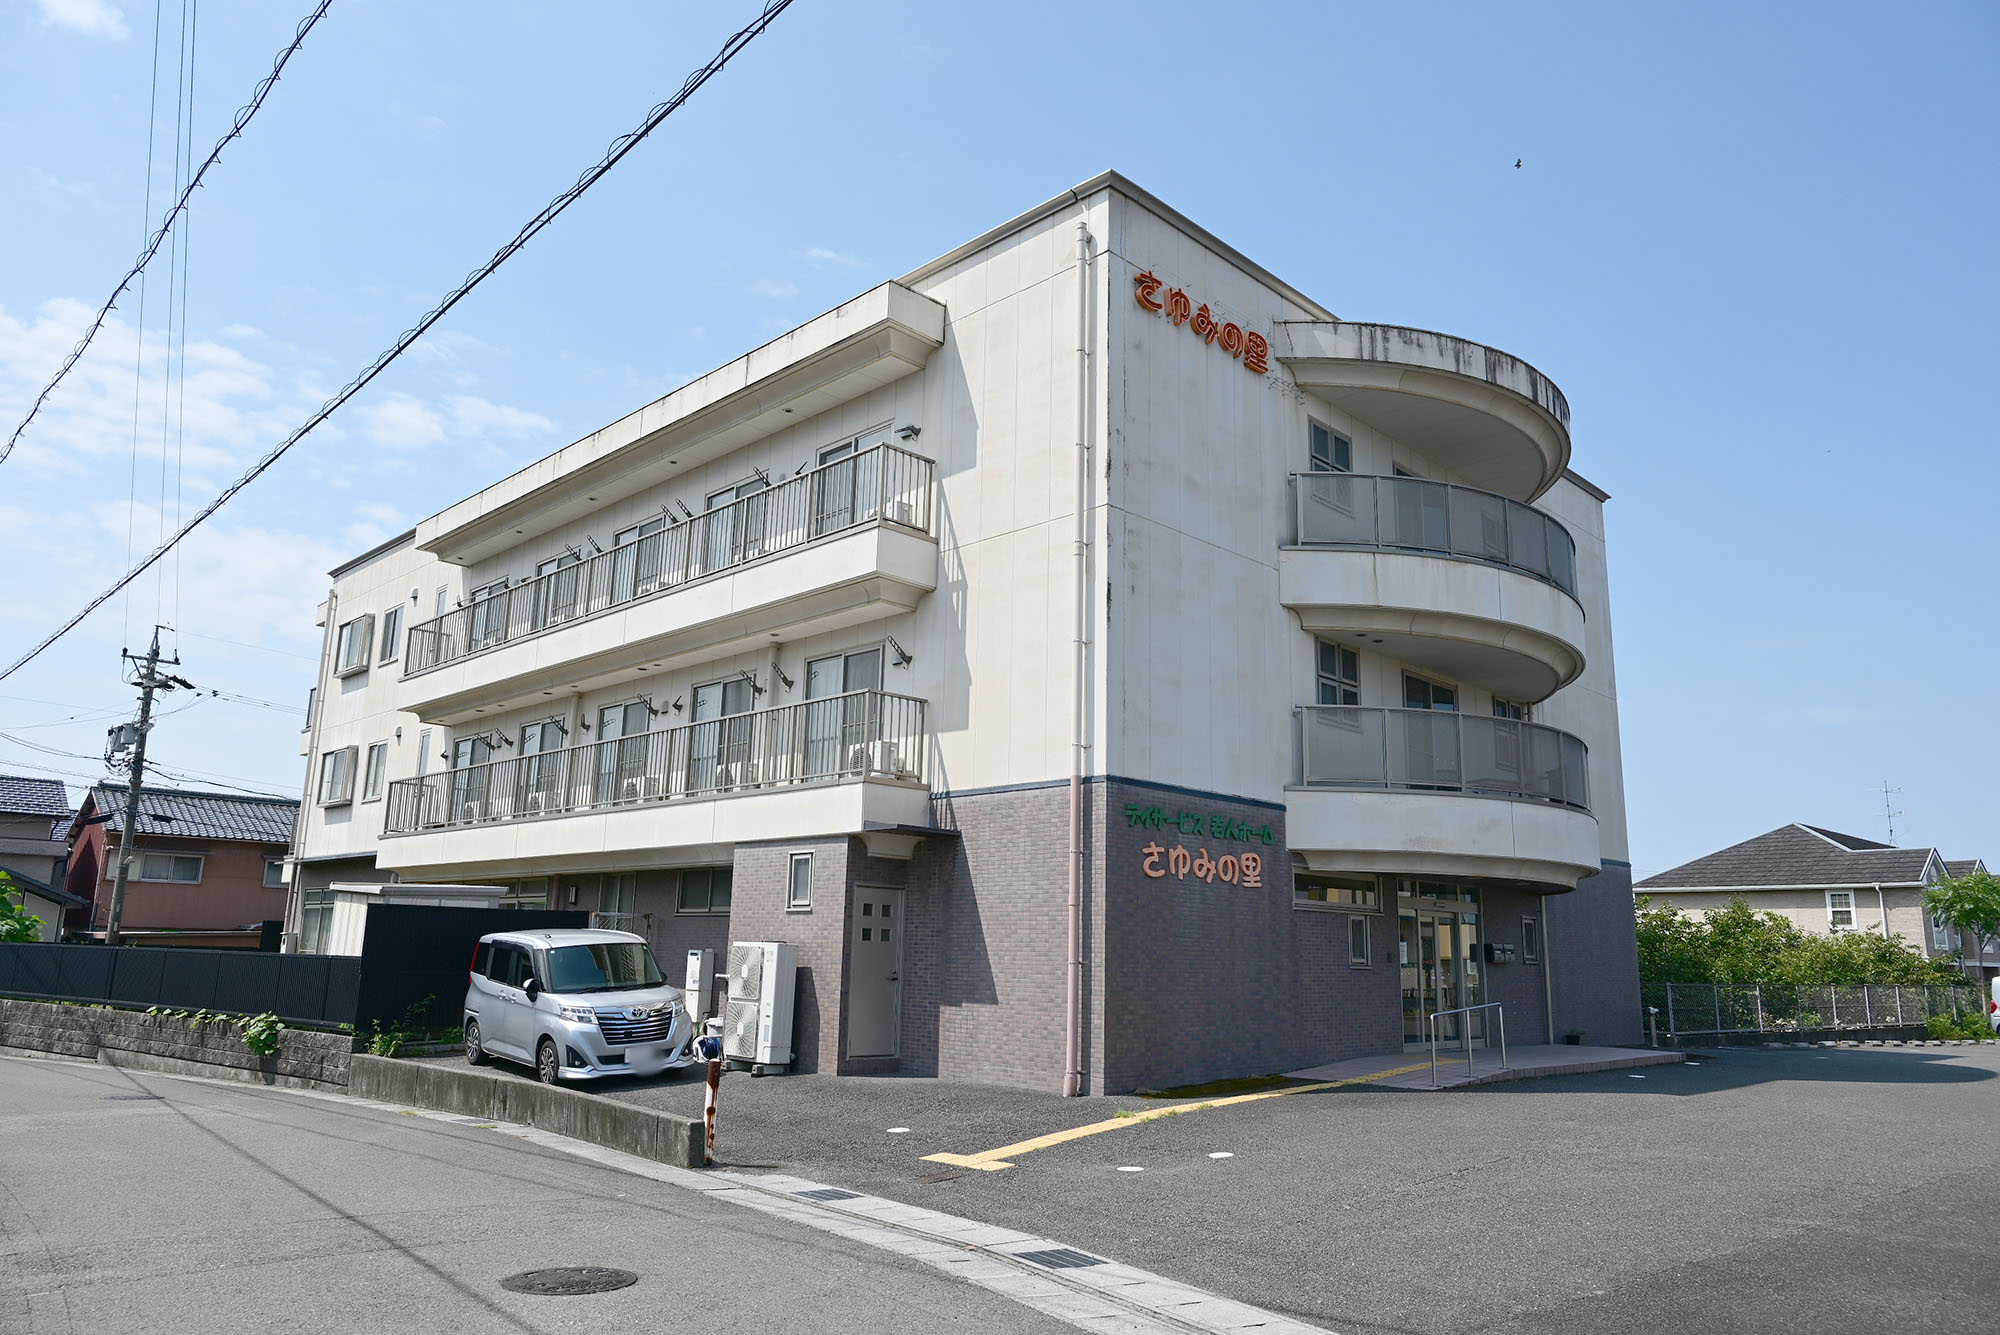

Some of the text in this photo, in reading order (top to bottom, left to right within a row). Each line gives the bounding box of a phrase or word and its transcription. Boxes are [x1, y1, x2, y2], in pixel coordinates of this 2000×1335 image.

[1134, 271, 1269, 374] さゆみの里
[1142, 841, 1262, 887] さゆみの里
